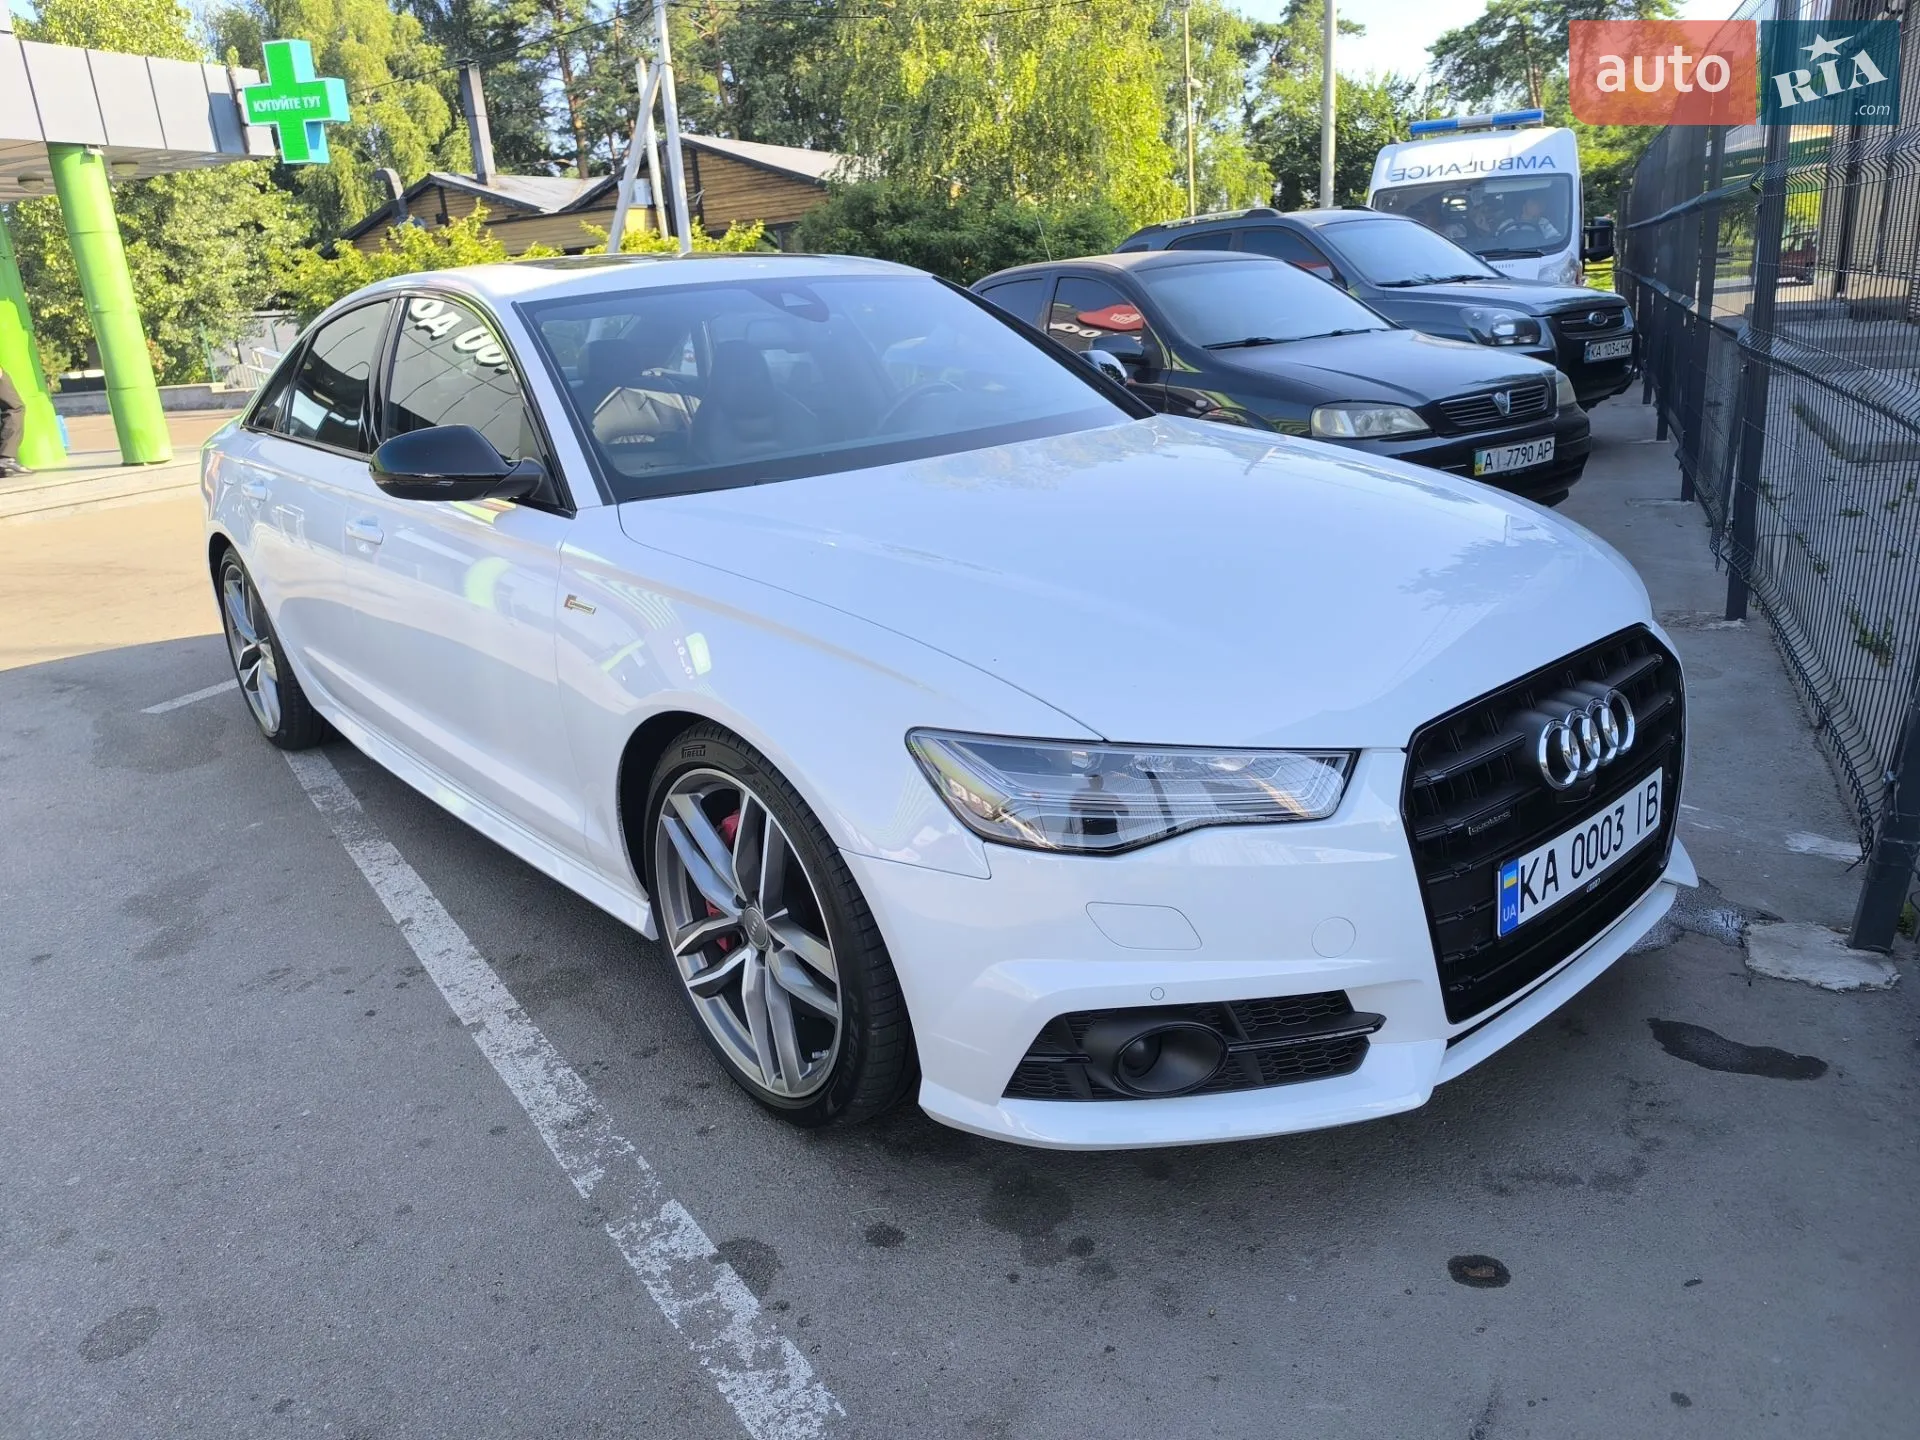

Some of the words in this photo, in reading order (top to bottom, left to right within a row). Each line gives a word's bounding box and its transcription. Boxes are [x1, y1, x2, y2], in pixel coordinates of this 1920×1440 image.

[1507, 445, 1534, 467] 7790
[1536, 440, 1552, 460] AP
[681, 744, 706, 759] PIRELLI
[1519, 848, 1559, 913] KA
[1571, 804, 1625, 879] 0003
[1636, 780, 1658, 835] IB
[1503, 905, 1517, 922] UA
